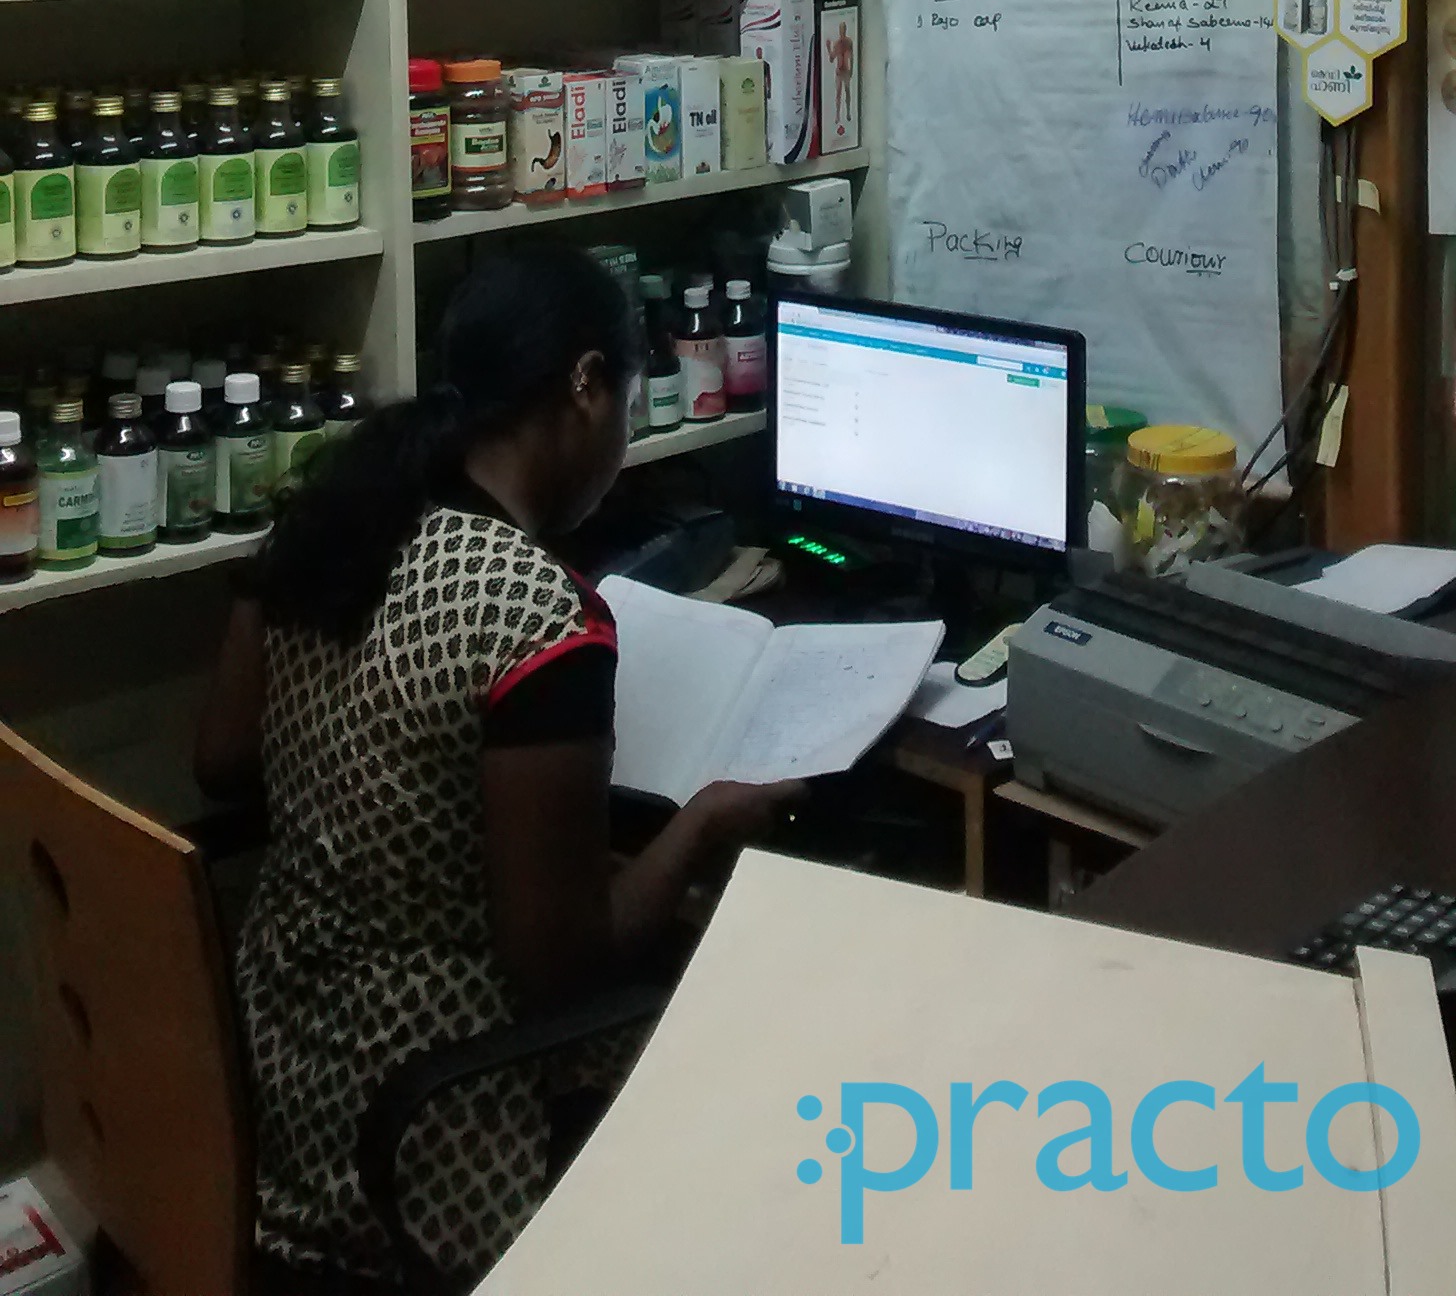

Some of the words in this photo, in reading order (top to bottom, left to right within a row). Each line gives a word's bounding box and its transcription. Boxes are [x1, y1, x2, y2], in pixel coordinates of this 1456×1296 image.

[570, 85, 586, 141] Eladi
[612, 79, 627, 135] Eladi
[688, 111, 704, 128] TN
